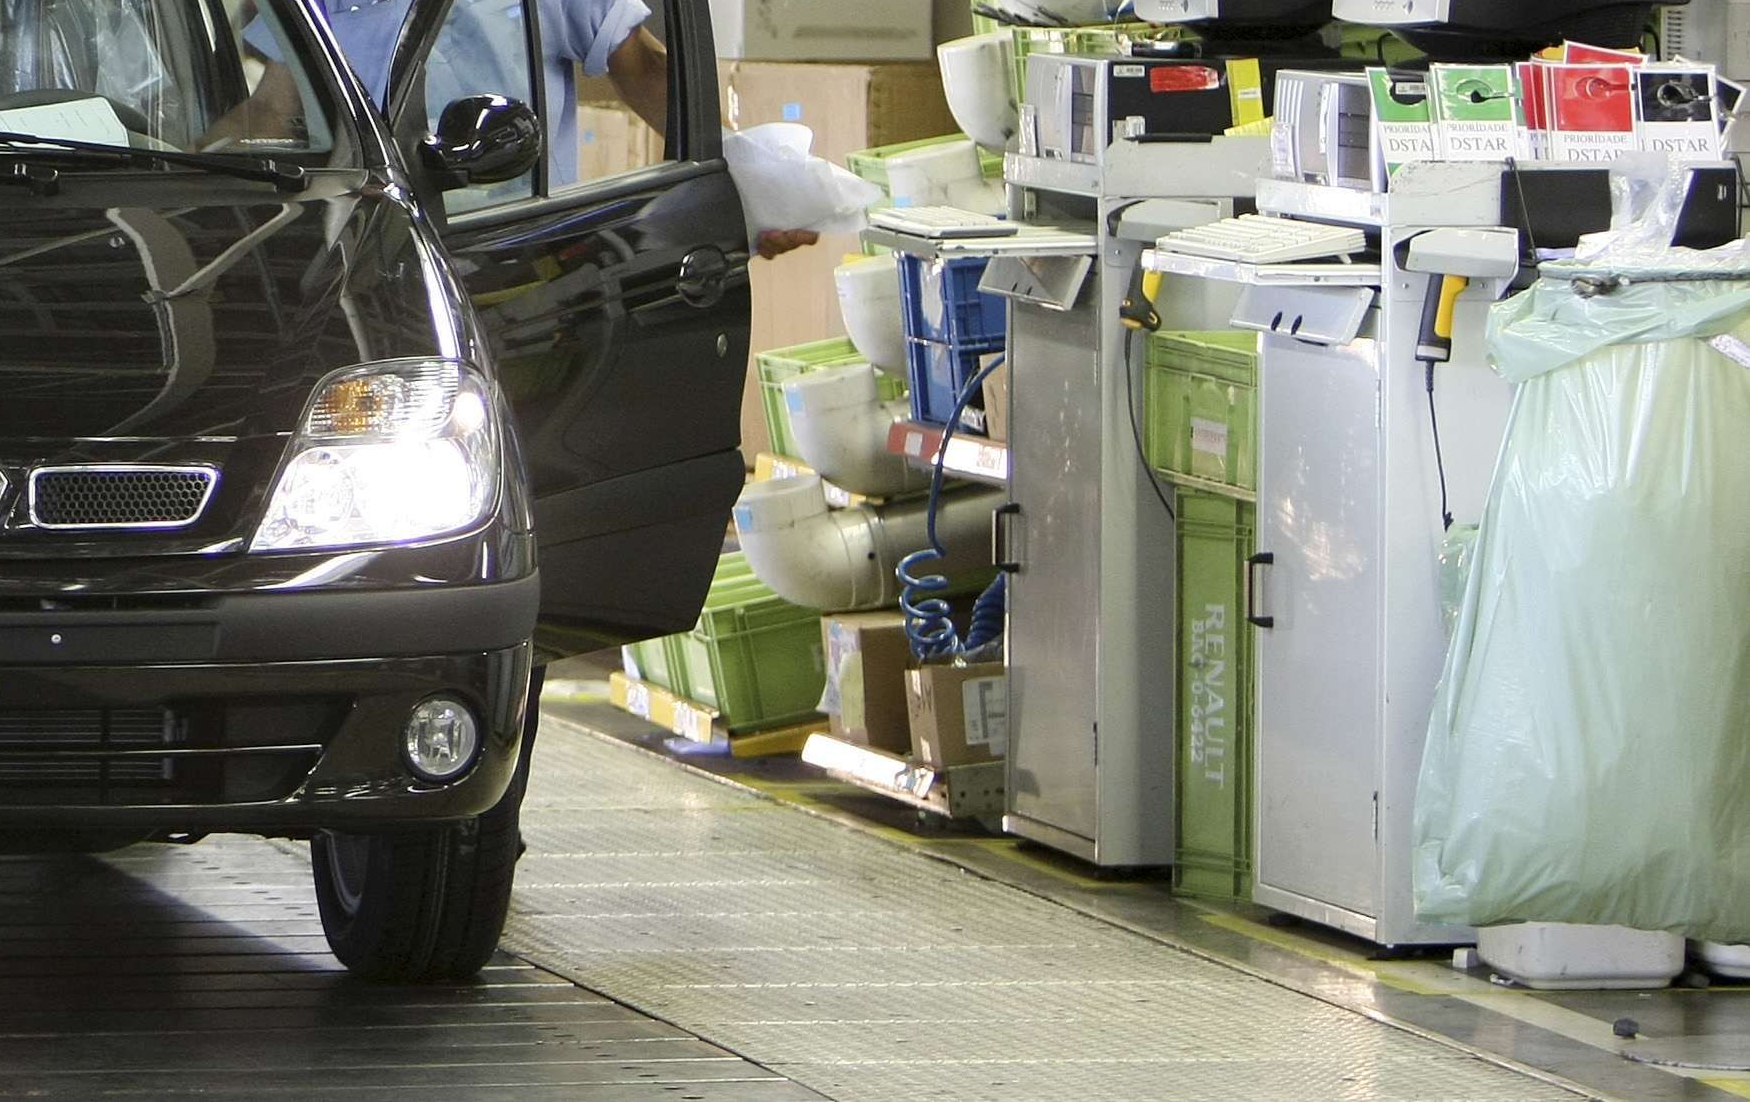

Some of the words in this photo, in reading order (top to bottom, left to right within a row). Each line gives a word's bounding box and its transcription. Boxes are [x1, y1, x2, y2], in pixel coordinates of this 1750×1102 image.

[1388, 138, 1432, 152] DSTA
[1450, 137, 1508, 151] DSTAR
[1652, 139, 1710, 153] DSTAR
[1205, 604, 1226, 790] RENAULT
